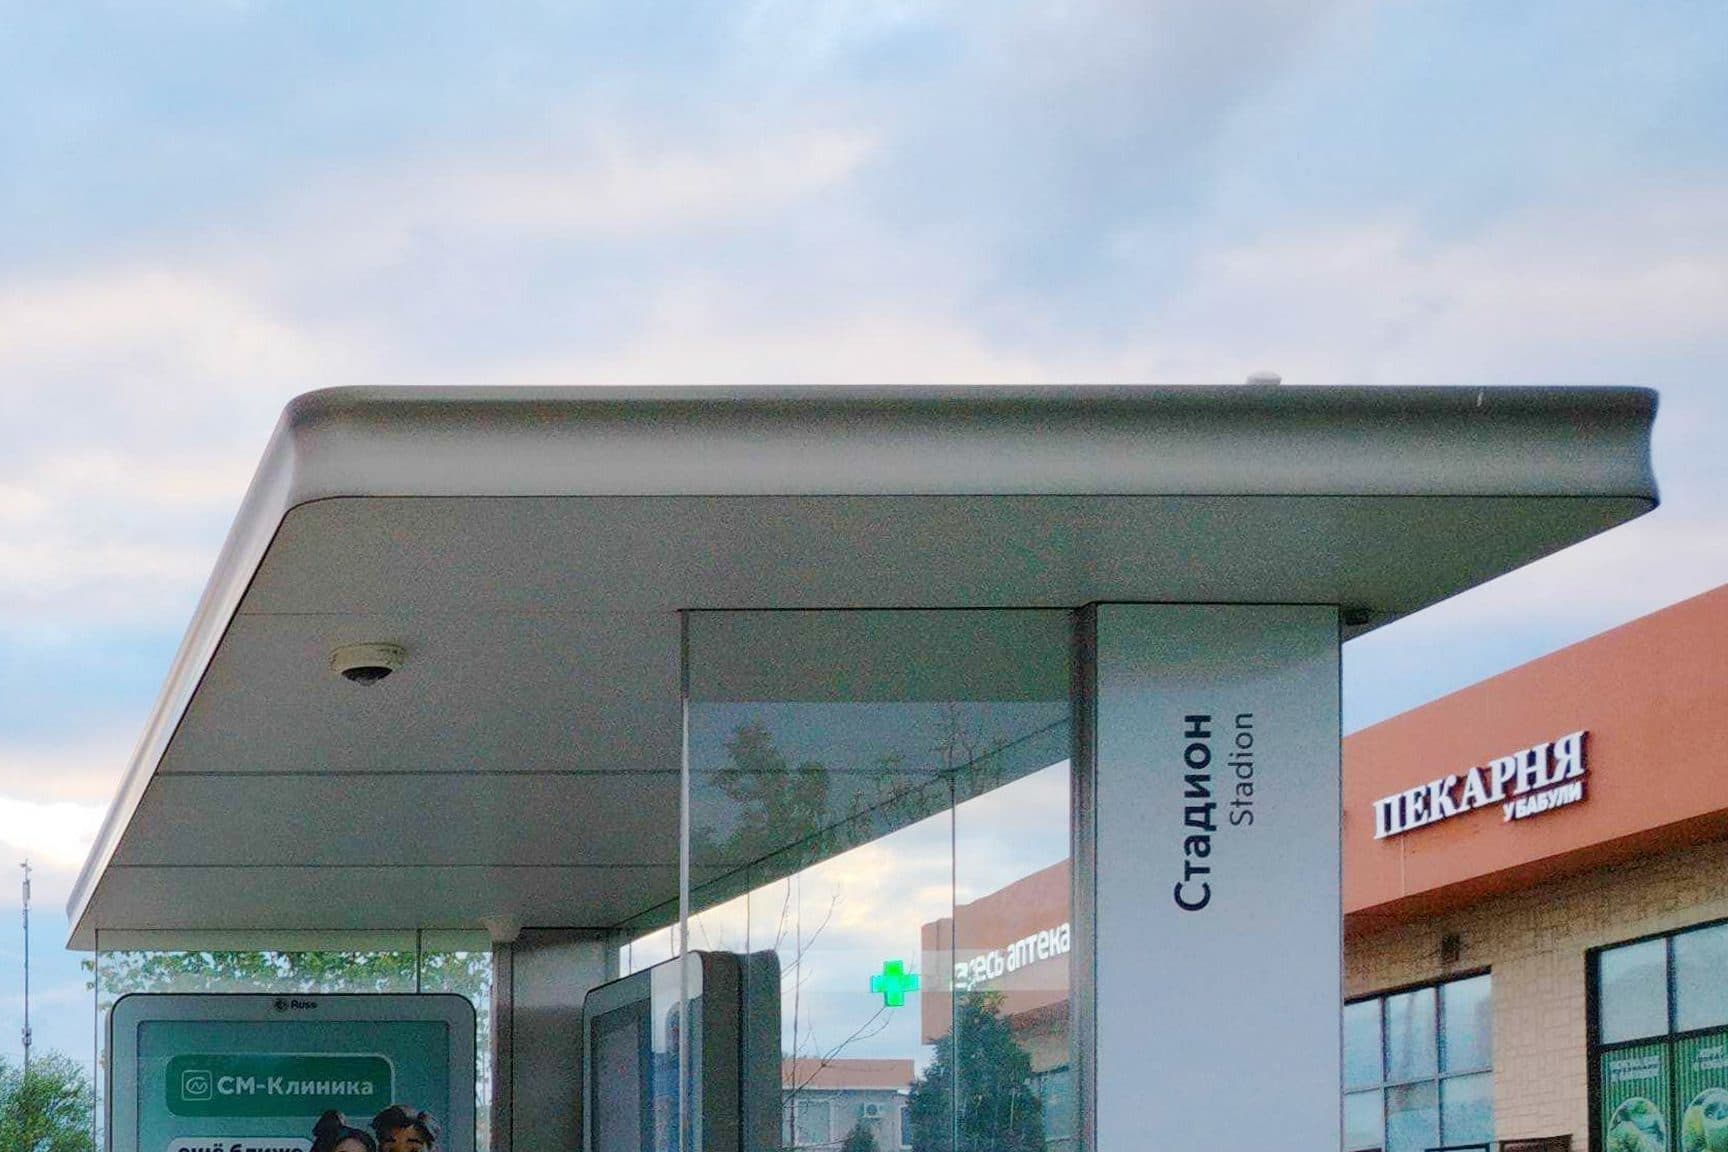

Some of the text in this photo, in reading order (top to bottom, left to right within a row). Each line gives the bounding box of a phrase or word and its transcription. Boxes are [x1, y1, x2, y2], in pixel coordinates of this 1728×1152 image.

[1174, 714, 1217, 912] Стадион
[1227, 712, 1254, 827] Stadion
[1372, 730, 1586, 840] ПЕКАРНЯ
[1007, 922, 1071, 972] аптека
[217, 1075, 373, 1096] СМ-Клиника
